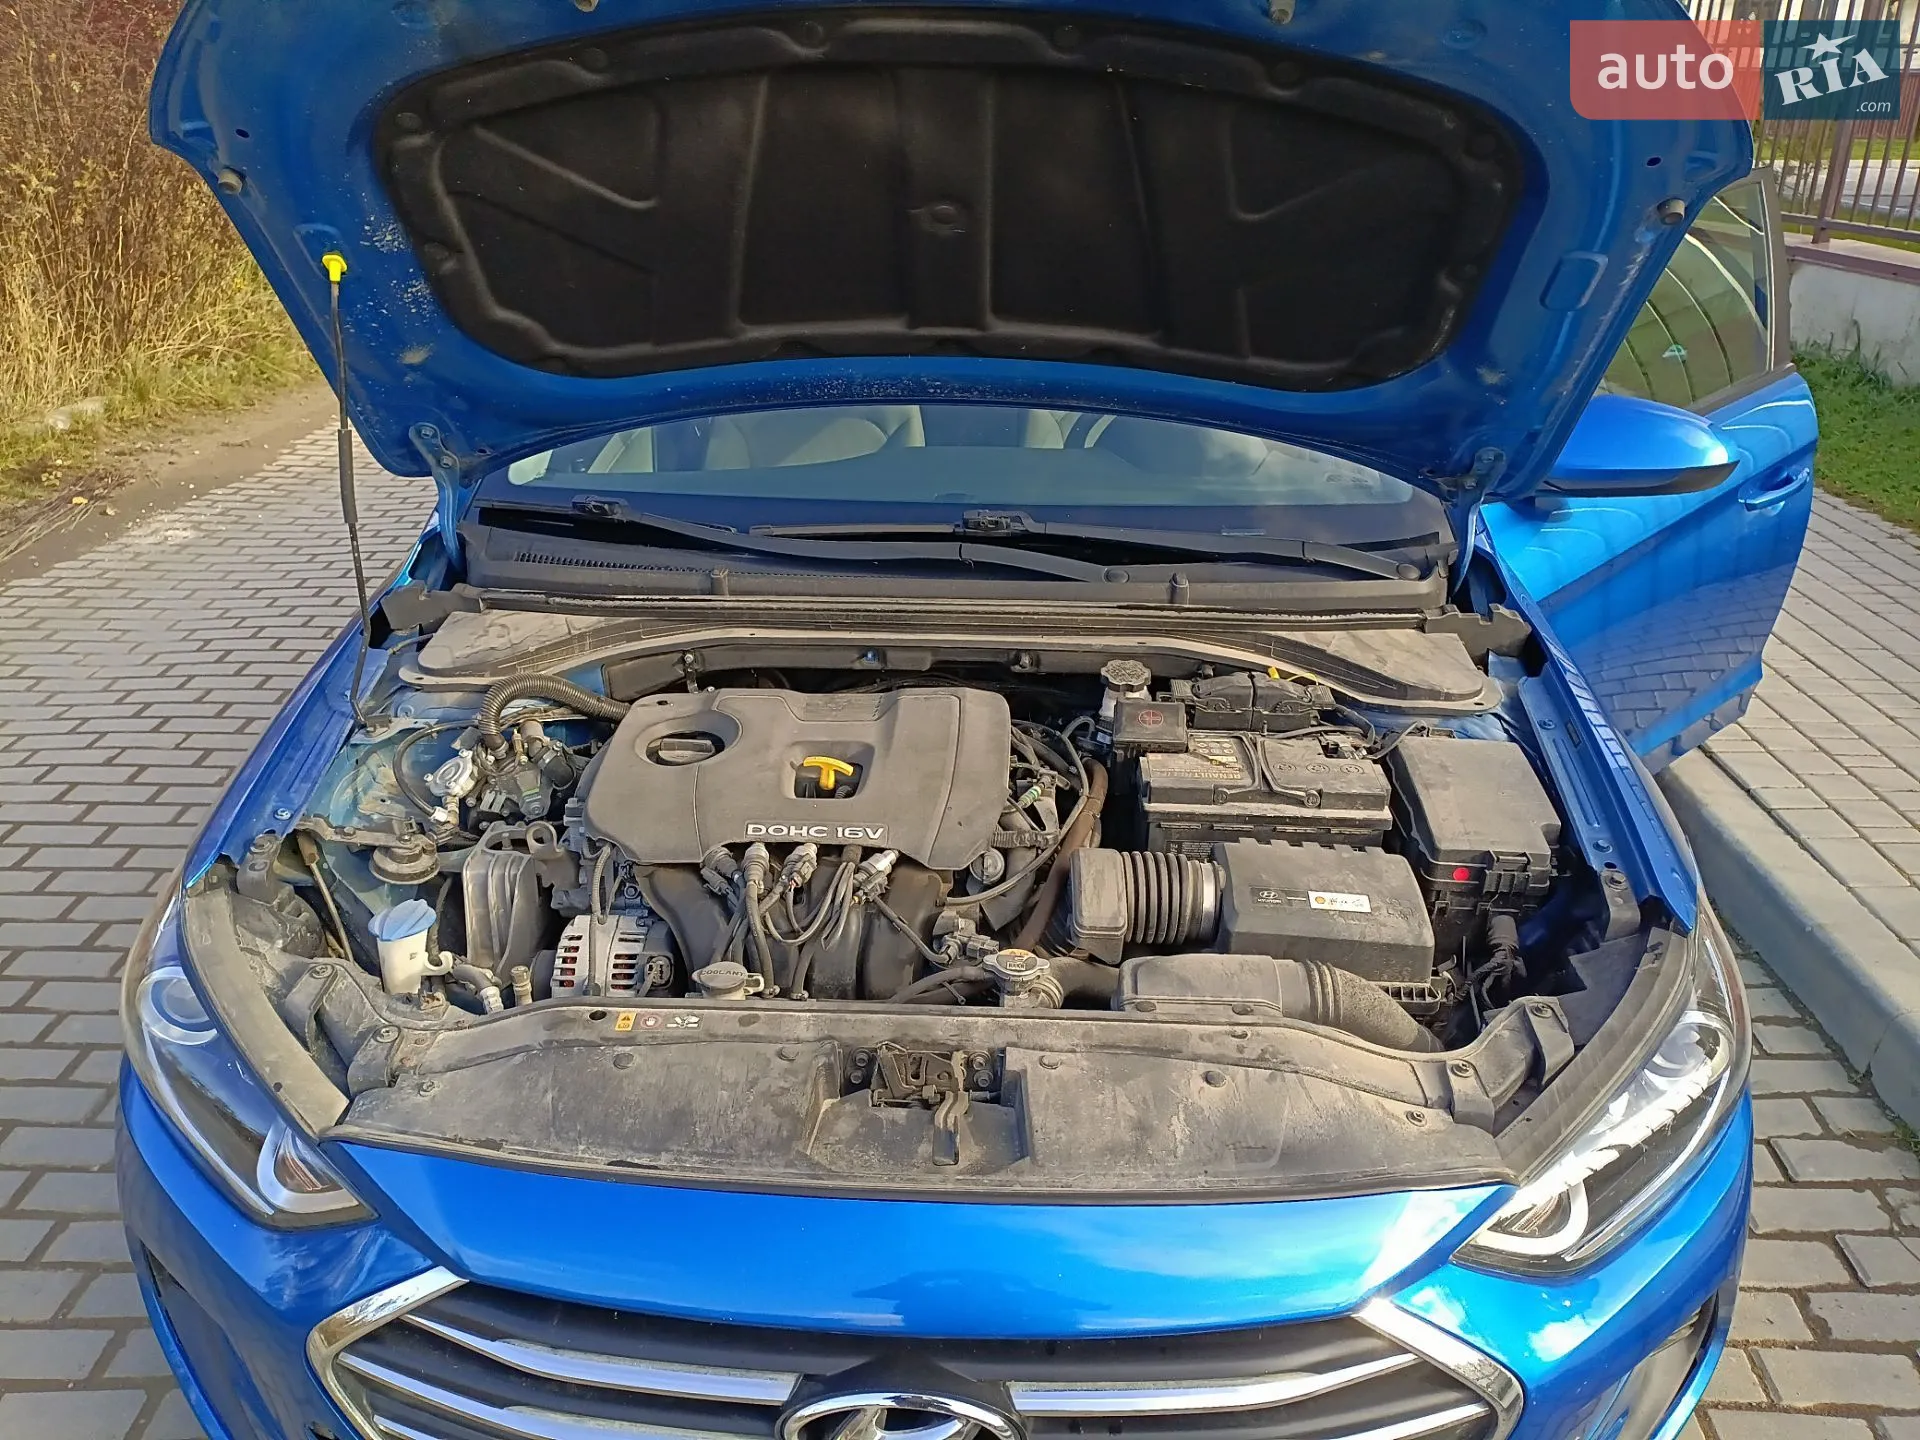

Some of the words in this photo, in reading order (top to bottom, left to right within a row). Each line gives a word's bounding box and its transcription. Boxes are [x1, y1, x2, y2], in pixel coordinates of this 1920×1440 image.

[746, 823, 828, 837] DOHC
[836, 826, 885, 840] 16V
[701, 969, 745, 977] COOLANT
